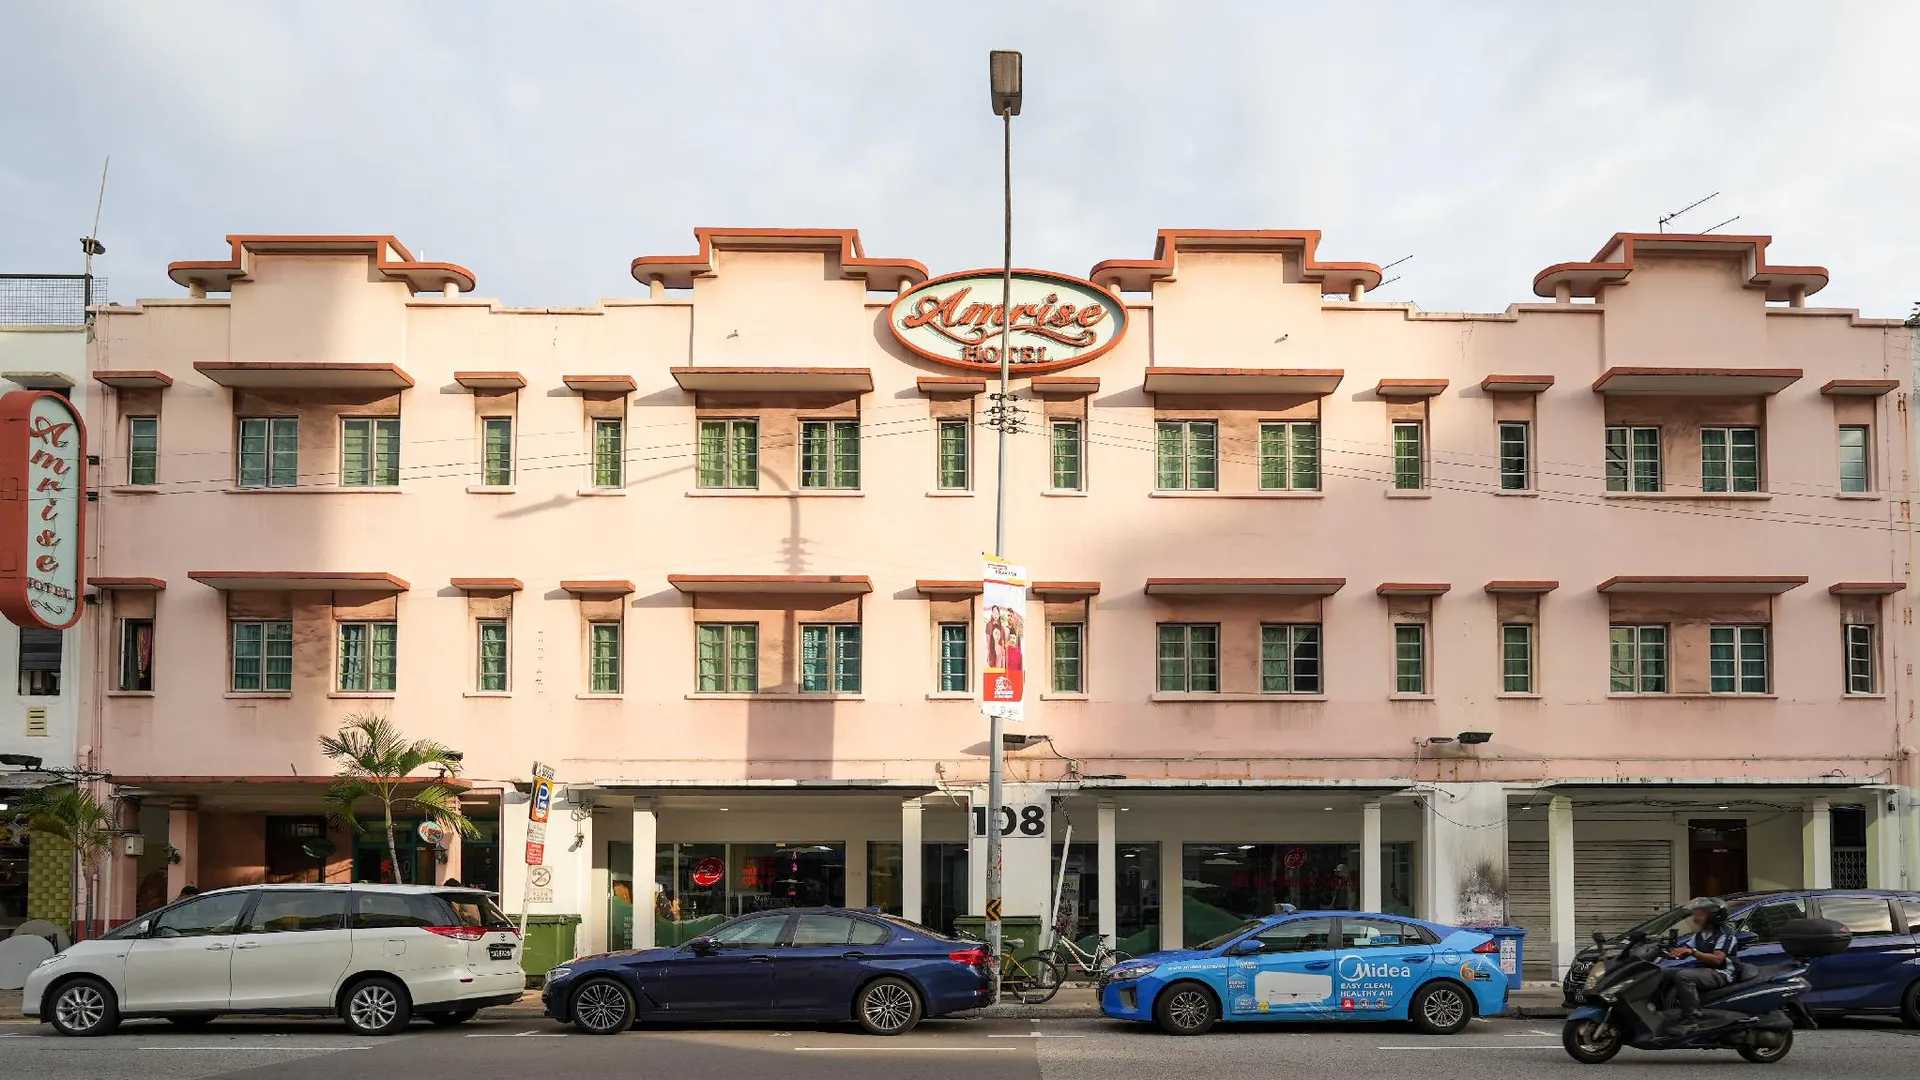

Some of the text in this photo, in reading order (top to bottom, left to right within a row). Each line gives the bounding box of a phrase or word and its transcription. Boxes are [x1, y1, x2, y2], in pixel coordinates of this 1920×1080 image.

[903, 286, 1109, 340] Amrise
[962, 346, 1051, 363] HOTEL
[30, 416, 73, 573] Amrise
[972, 805, 1045, 836] 108
[1351, 963, 1411, 978] Midea
[1460, 961, 1475, 983] 6
[1364, 982, 1393, 990] CLEAN,
